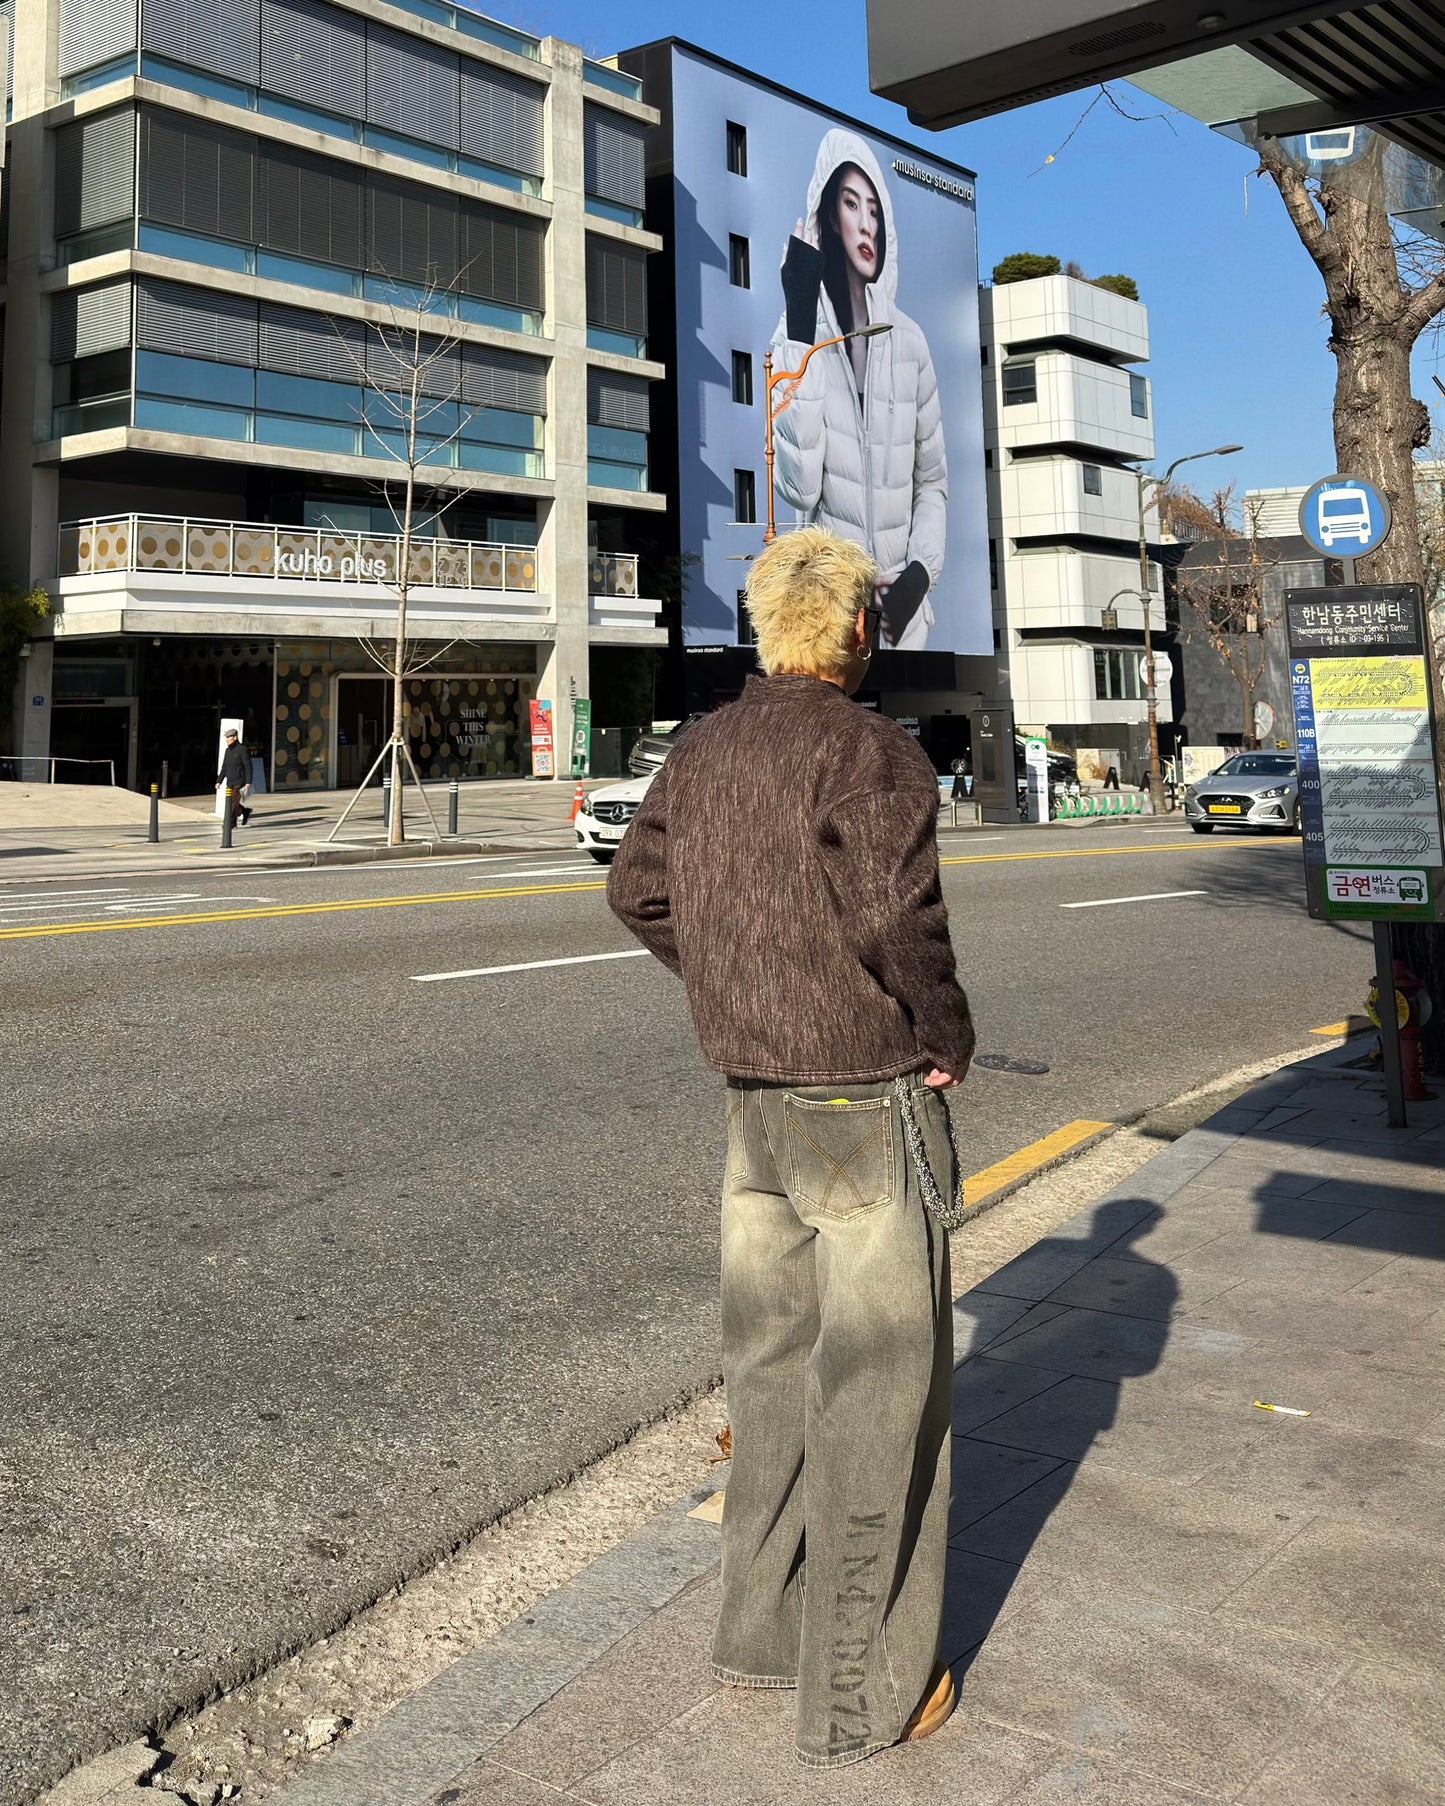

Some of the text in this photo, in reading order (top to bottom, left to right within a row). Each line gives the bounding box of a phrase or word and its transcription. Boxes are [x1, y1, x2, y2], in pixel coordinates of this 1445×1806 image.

[896, 159, 974, 201] musinsa standard
[274, 545, 387, 582] kuho plus
[1302, 602, 1401, 626] 한남동주민센터
[1368, 624, 1388, 632] Service
[1292, 675, 1310, 684] N72
[460, 709, 486, 718] SHINE
[463, 721, 484, 731] THIS
[1297, 728, 1315, 738] 110B
[456, 735, 491, 744] WINTER
[1301, 780, 1320, 790] 400
[1305, 832, 1324, 841] 405
[1332, 874, 1395, 897] 금연 버스
[1372, 886, 1395, 895] 정류소
